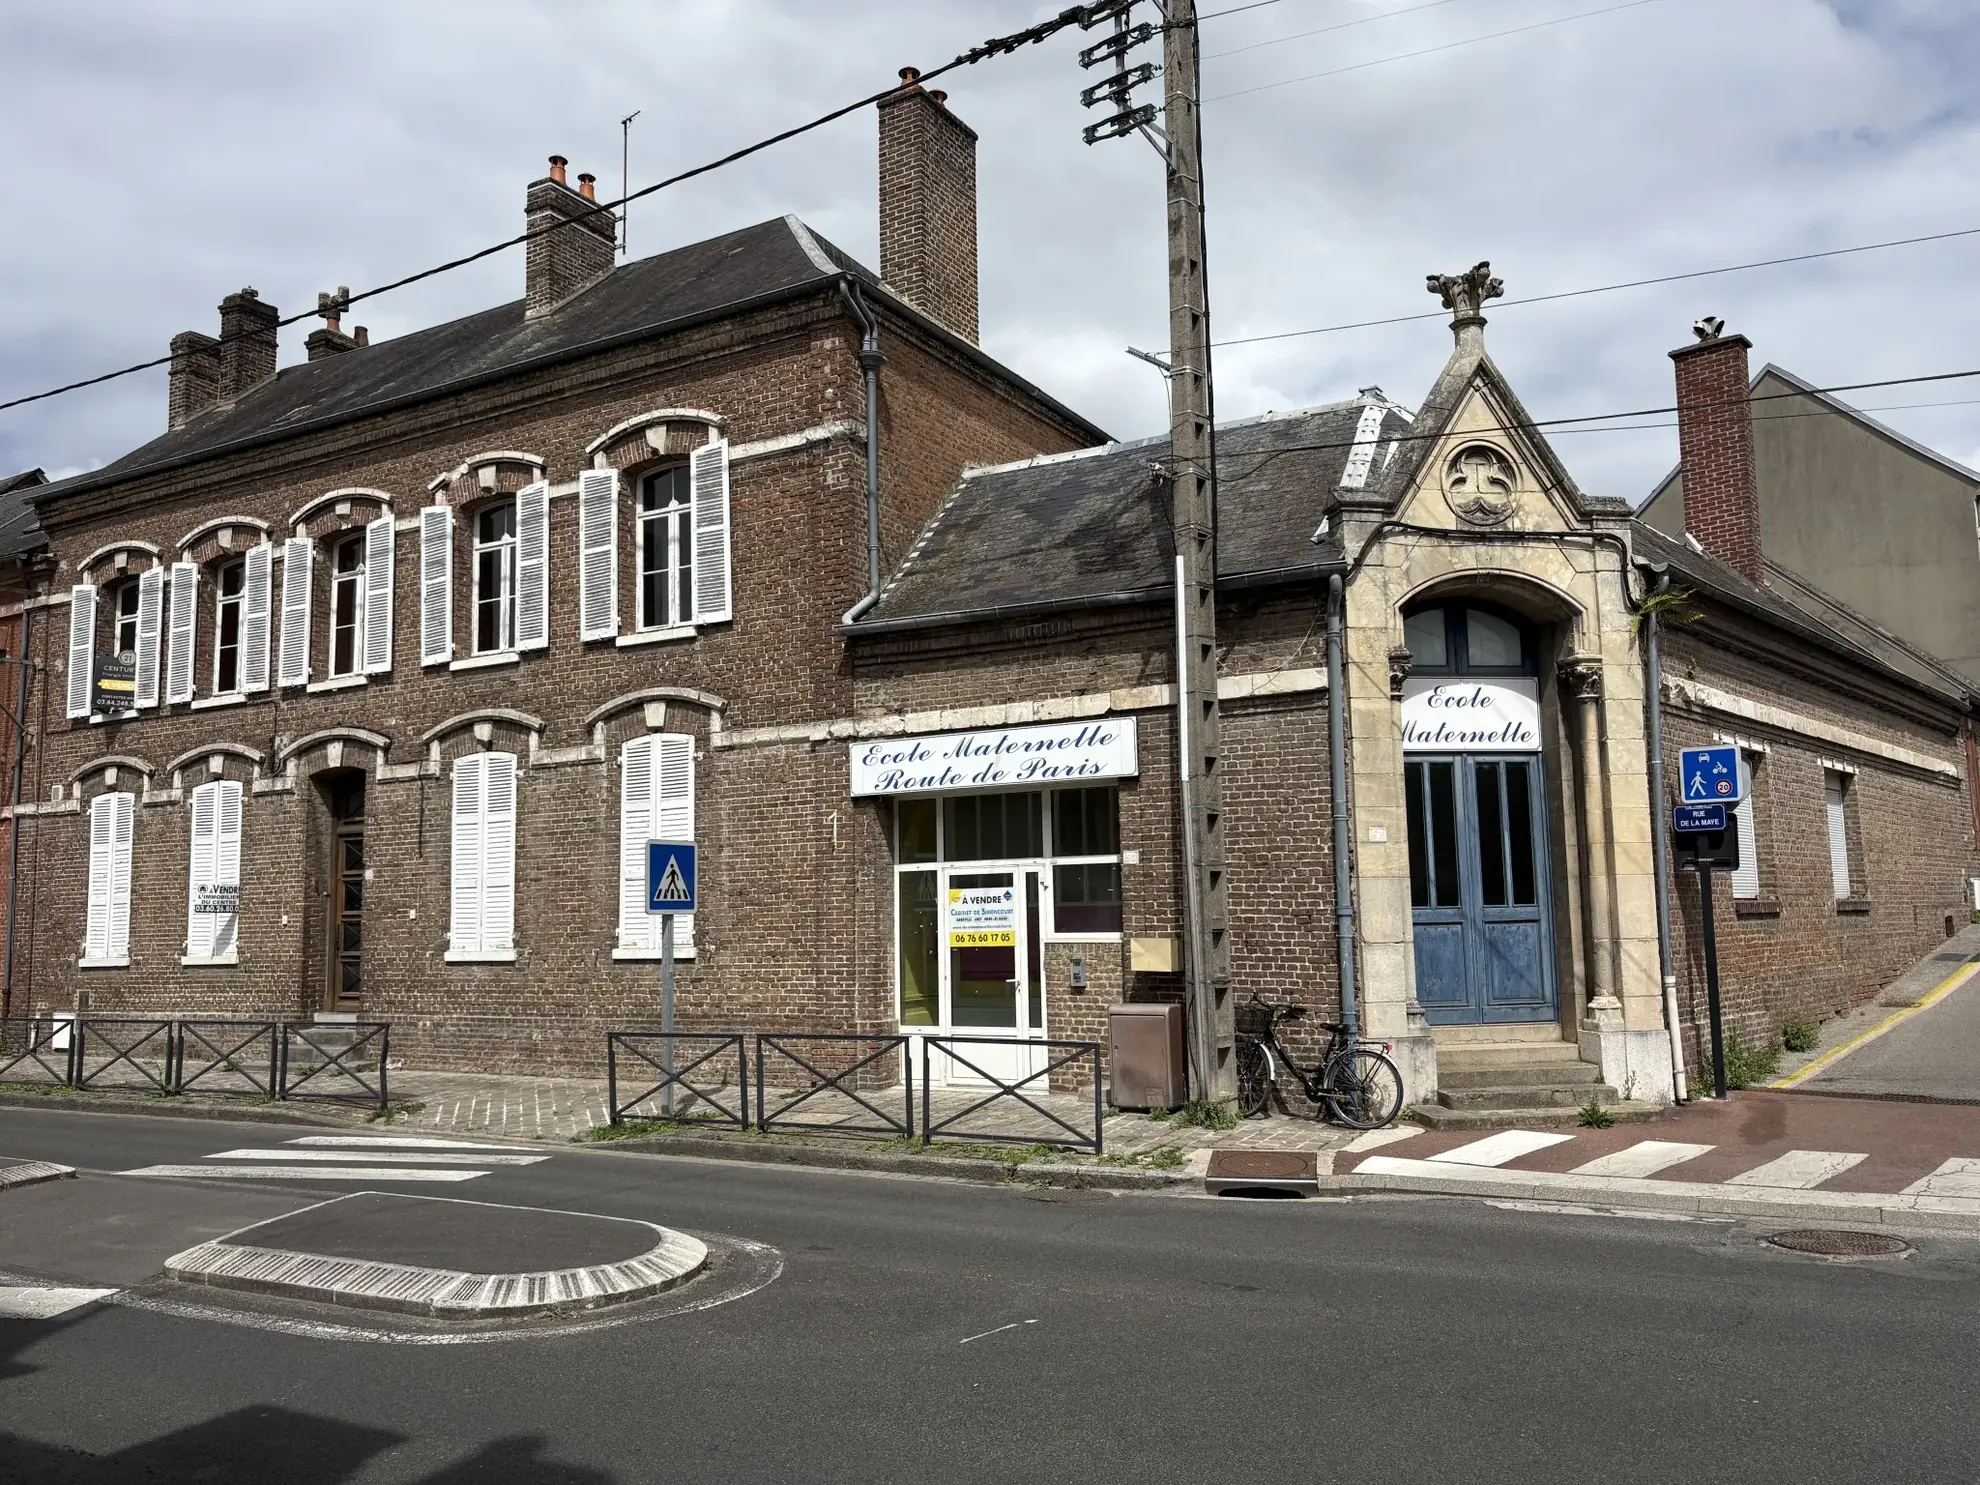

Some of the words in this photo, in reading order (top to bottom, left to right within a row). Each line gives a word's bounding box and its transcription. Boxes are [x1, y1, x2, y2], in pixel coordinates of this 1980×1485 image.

[1427, 685, 1496, 708] Ecole
[862, 742, 937, 766] Ecole
[943, 725, 1120, 759] Maternelle
[874, 766, 969, 791] Route
[972, 763, 1012, 783] de
[1016, 757, 1108, 780] Paris
[970, 896, 1002, 904] VENDRE
[955, 935, 965, 943] 06
[967, 934, 976, 942] 76
[978, 934, 988, 942] 60
[991, 934, 999, 942] 17
[1001, 933, 1010, 941] 05
